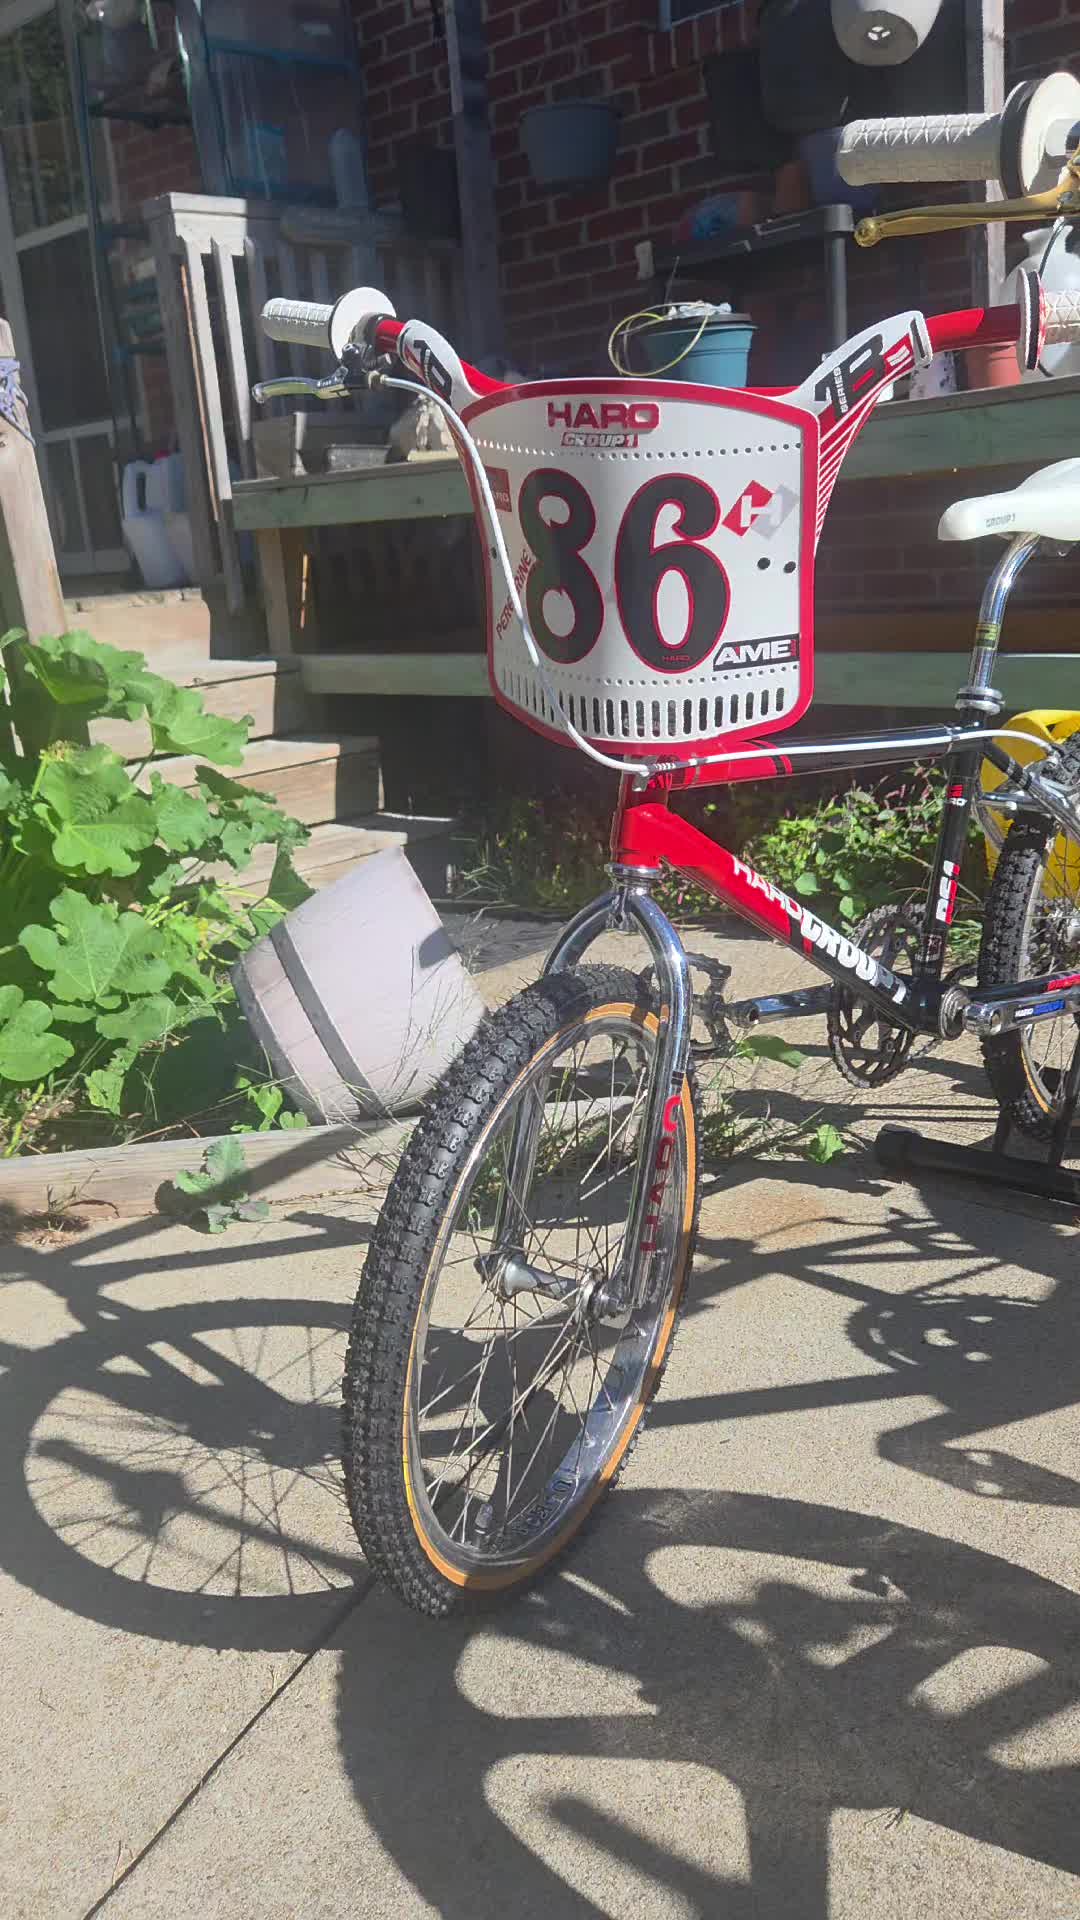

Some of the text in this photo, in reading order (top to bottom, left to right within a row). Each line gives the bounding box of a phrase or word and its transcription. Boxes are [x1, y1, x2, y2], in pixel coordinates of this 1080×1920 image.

[833, 366, 849, 414] SERIES
[547, 401, 660, 430] HARO
[496, 549, 532, 640] PERERINE
[518, 467, 731, 674] 86
[715, 639, 792, 666] AME
